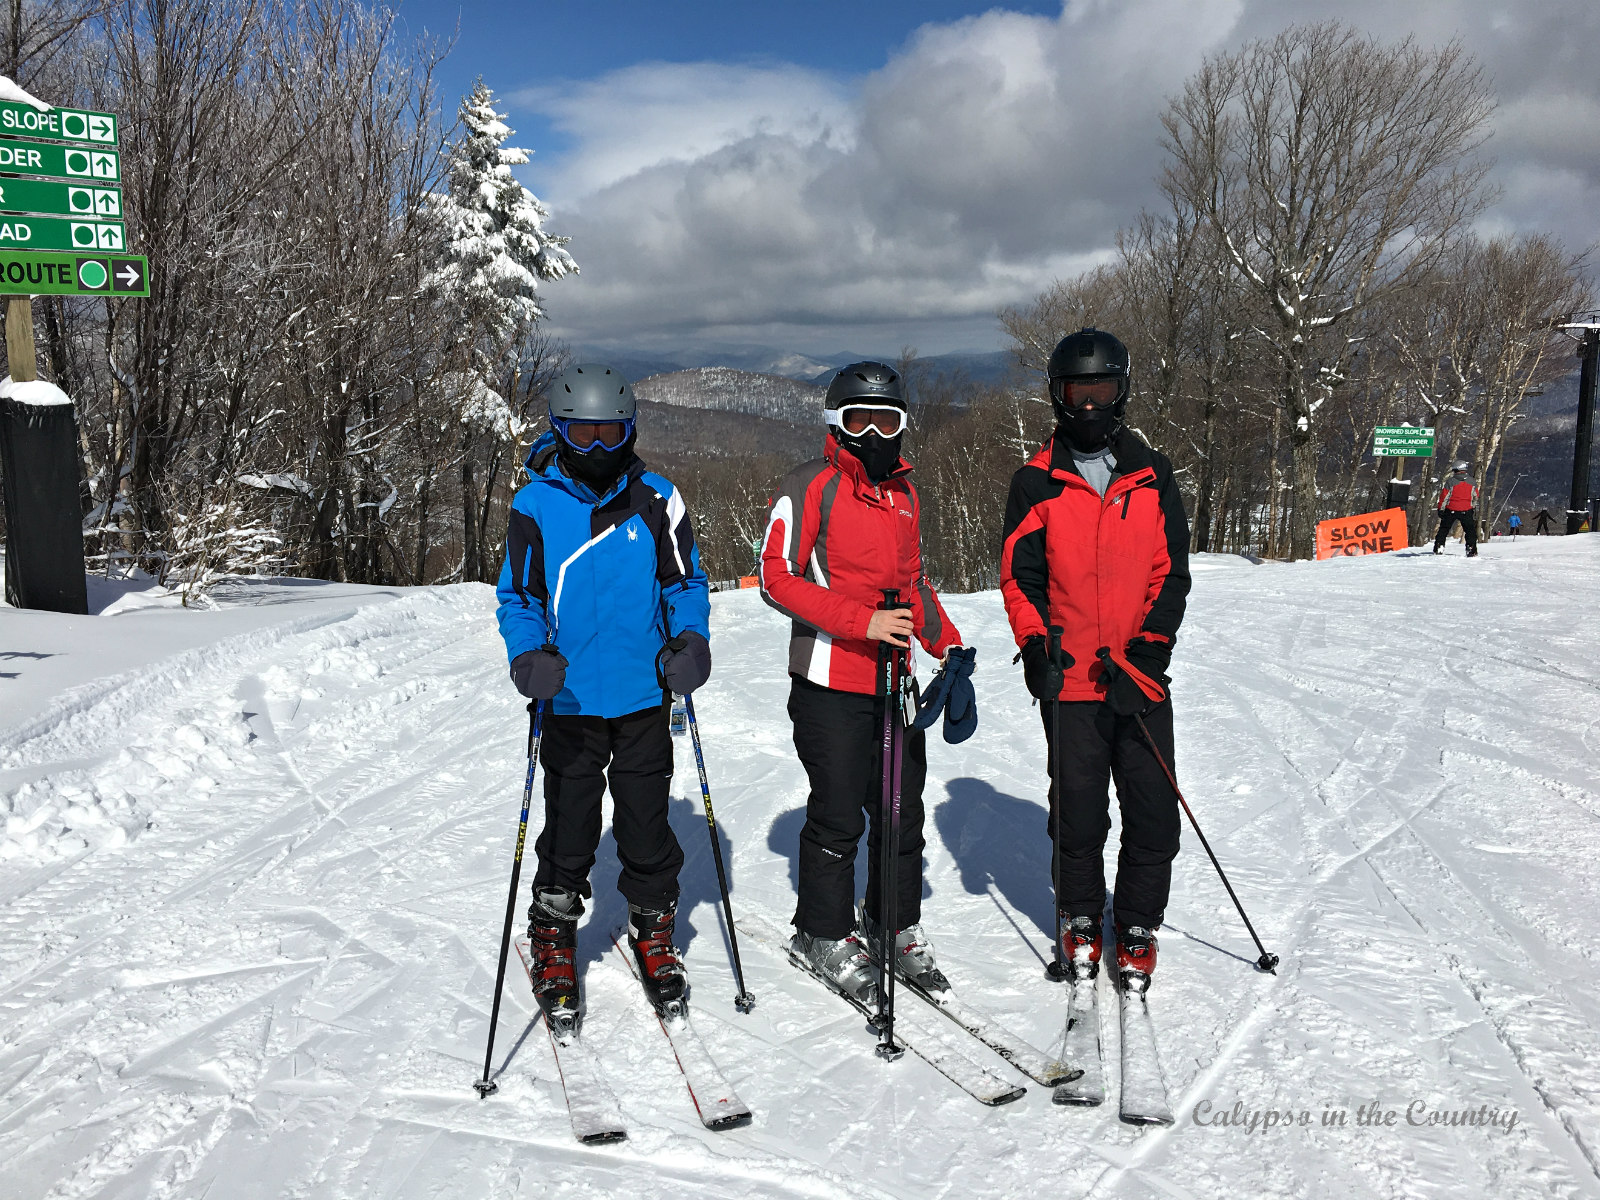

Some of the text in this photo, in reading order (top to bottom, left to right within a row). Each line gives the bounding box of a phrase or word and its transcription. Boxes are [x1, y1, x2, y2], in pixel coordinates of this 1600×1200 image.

[2, 109, 59, 132] SLOPE
[0, 223, 31, 241] AD
[1330, 519, 1391, 541] SLOW
[1330, 536, 1393, 558] ZONE
